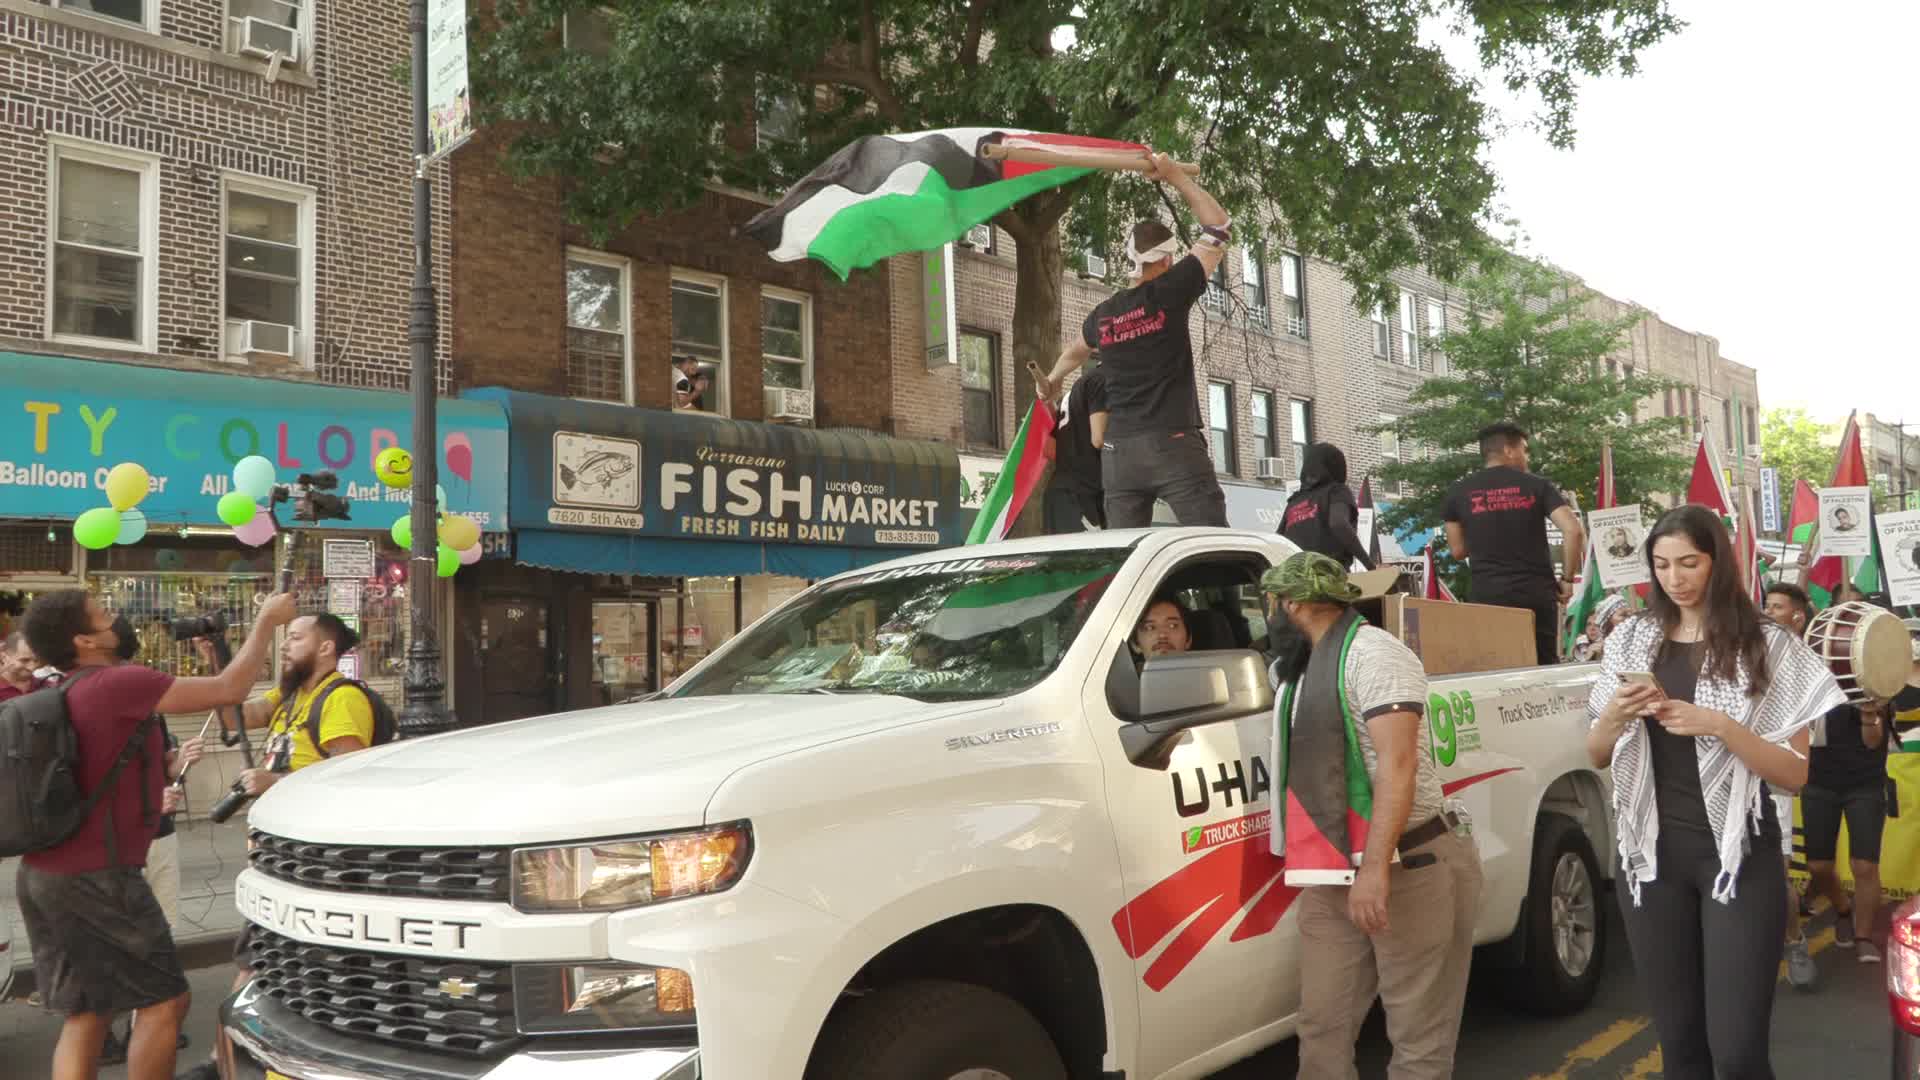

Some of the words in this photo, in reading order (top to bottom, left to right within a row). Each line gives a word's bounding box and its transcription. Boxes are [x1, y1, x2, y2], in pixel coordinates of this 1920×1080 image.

[1112, 306, 1145, 324] WITHIN
[0, 461, 87, 489] Balloon
[95, 467, 167, 493] Cer
[200, 473, 228, 496] All
[346, 480, 379, 502] And
[660, 461, 812, 521] FISH
[825, 481, 851, 493] LUCKY
[1762, 470, 1771, 491] EYE
[554, 510, 584, 524] 7620
[591, 512, 610, 526] 5th
[614, 514, 641, 528] Ave.
[821, 493, 939, 527] MARKET
[681, 515, 740, 536] FRESH
[750, 520, 789, 539] FISH
[798, 523, 846, 542] DAILY
[1884, 527, 1896, 535] OF
[863, 559, 985, 584] U-HAUL
[1498, 703, 1523, 726] Truck
[1523, 701, 1550, 720] Share
[945, 721, 1065, 751] SILVERADO
[1171, 755, 1270, 818] U-HA
[1203, 822, 1240, 846] TRUCK
